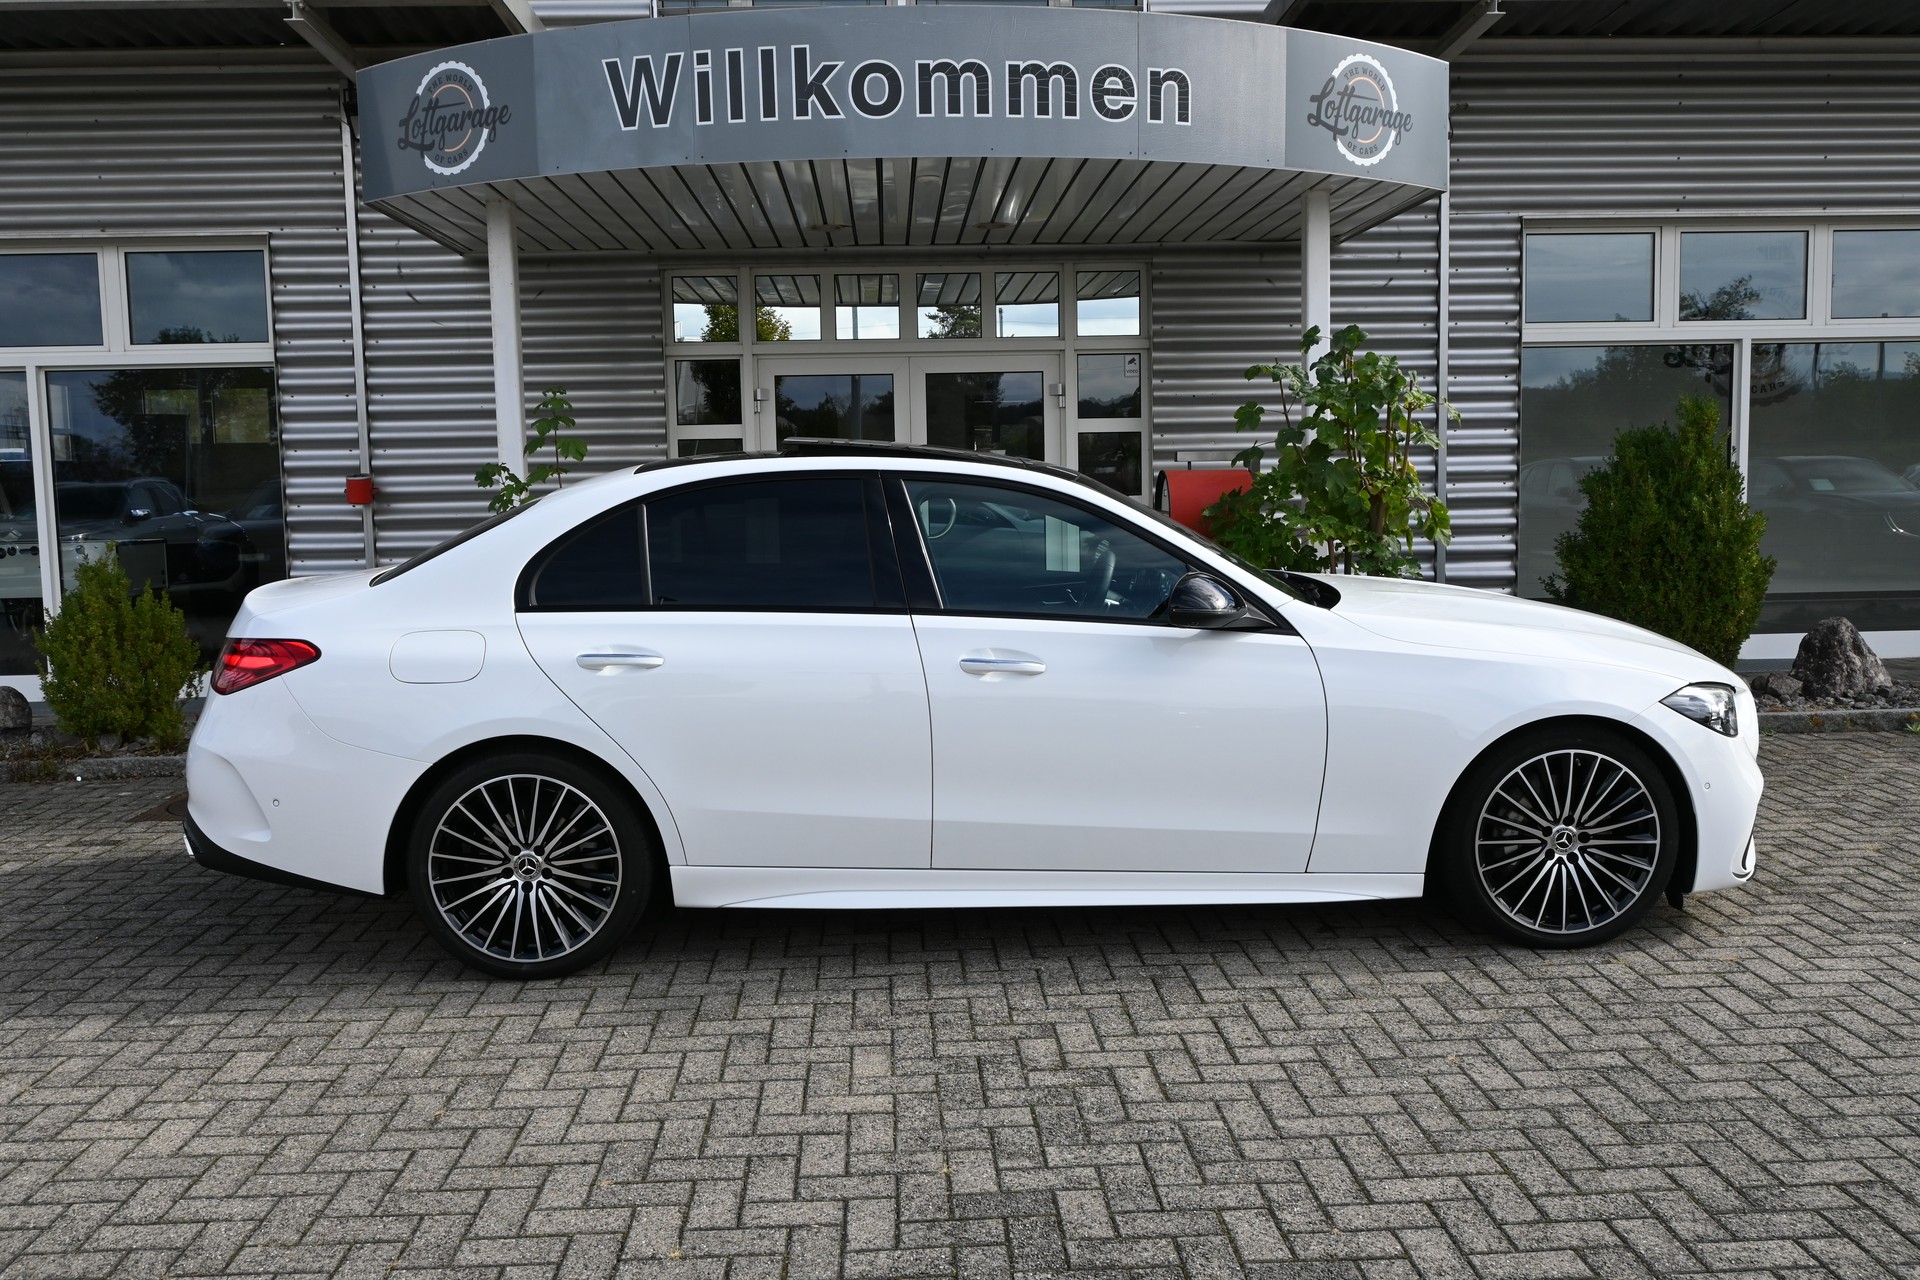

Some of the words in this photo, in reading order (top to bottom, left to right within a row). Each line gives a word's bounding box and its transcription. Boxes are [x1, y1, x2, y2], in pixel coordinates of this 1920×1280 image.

[428, 77, 443, 93] THE
[445, 74, 474, 92] WORLD
[601, 43, 1192, 131] Willkommen
[1344, 67, 1360, 81] THE
[1362, 67, 1386, 92] WORLD
[1307, 75, 1413, 145] Loftgarage
[397, 94, 512, 159] Loftgarage
[434, 154, 445, 163] OF
[447, 148, 469, 163] CARS
[1347, 141, 1358, 151] OF
[1359, 144, 1378, 155] CARS
[1751, 381, 1785, 394] CARS
